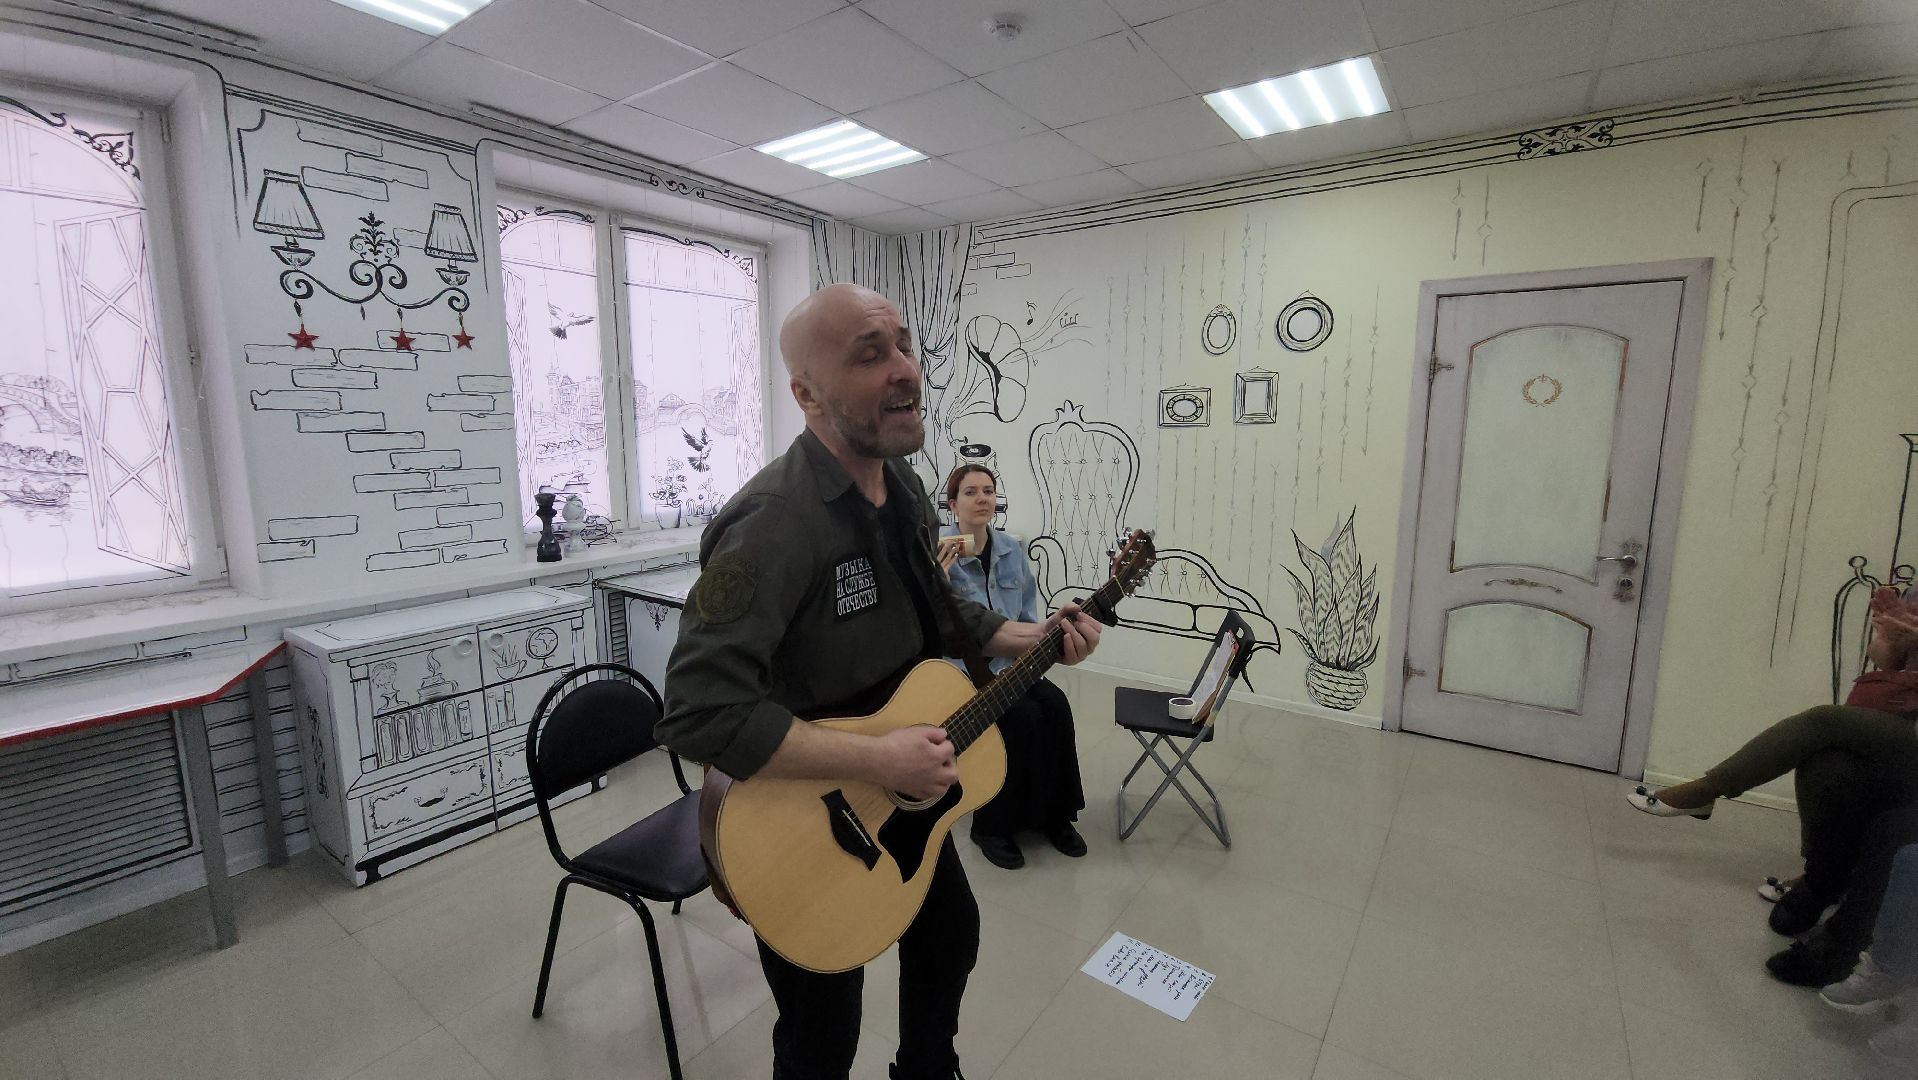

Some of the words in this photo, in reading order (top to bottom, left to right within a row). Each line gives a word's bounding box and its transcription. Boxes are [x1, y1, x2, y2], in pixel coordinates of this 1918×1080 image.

[835, 557, 872, 581] МУЗЫКА
[836, 582, 845, 599] НА
[845, 572, 876, 594] СЛУЖБЕ
[837, 587, 878, 616] ОТЕЧЕСТВУ
